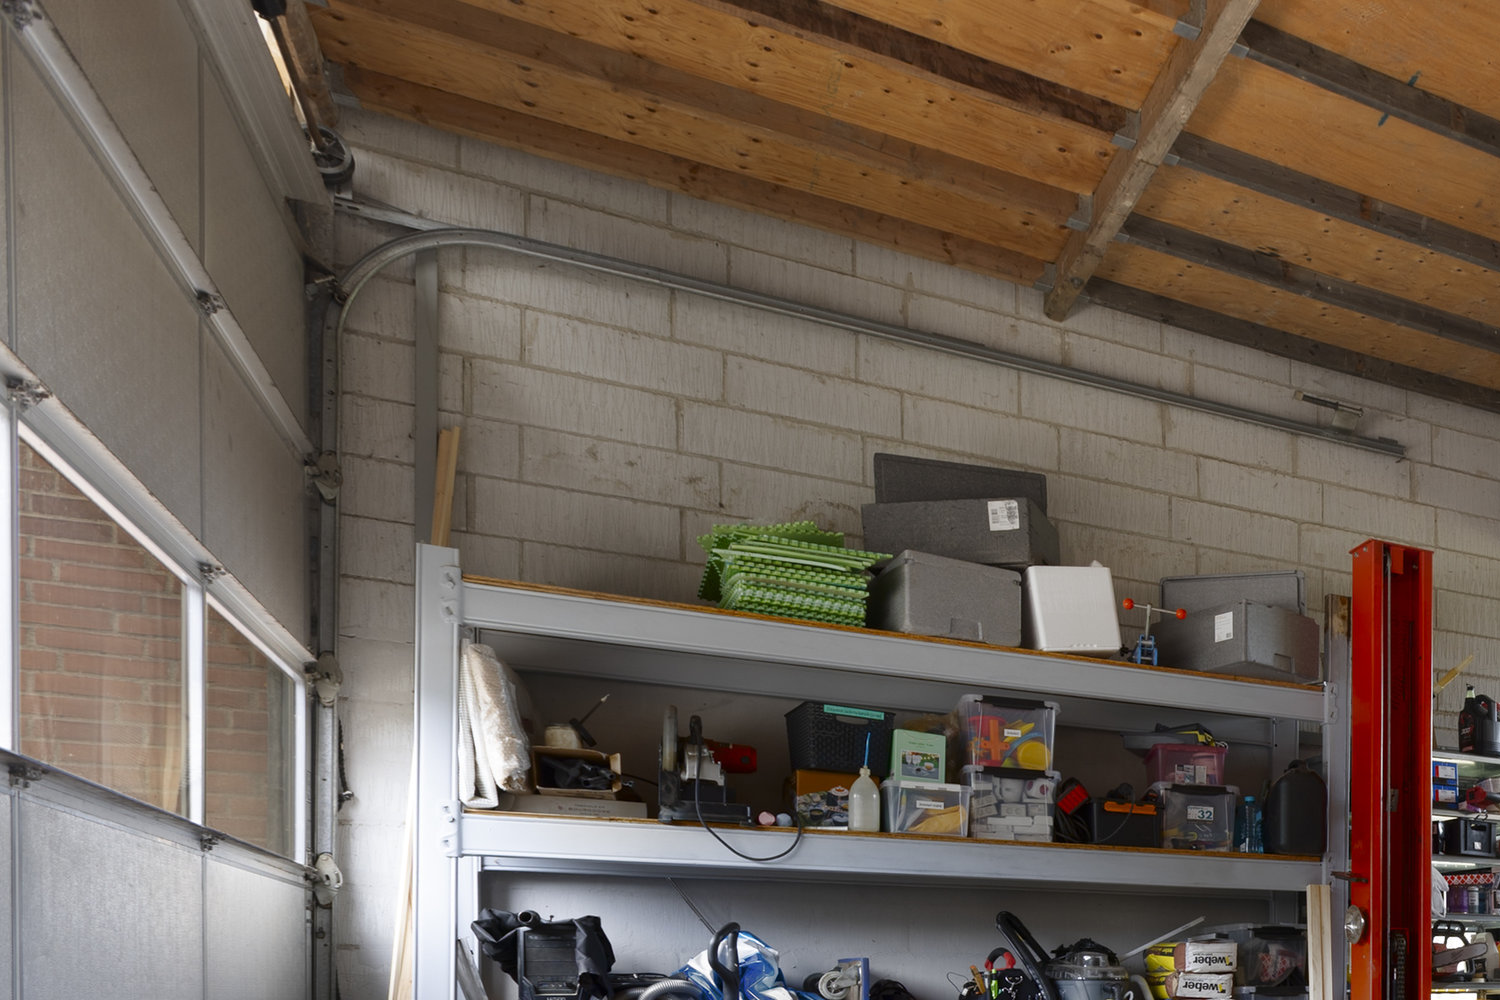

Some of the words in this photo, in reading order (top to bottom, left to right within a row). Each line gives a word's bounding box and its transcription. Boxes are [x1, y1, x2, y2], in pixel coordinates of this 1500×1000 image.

[1197, 810, 1213, 820] 32
[1193, 955, 1227, 966] weber
[1183, 981, 1220, 992] weber
